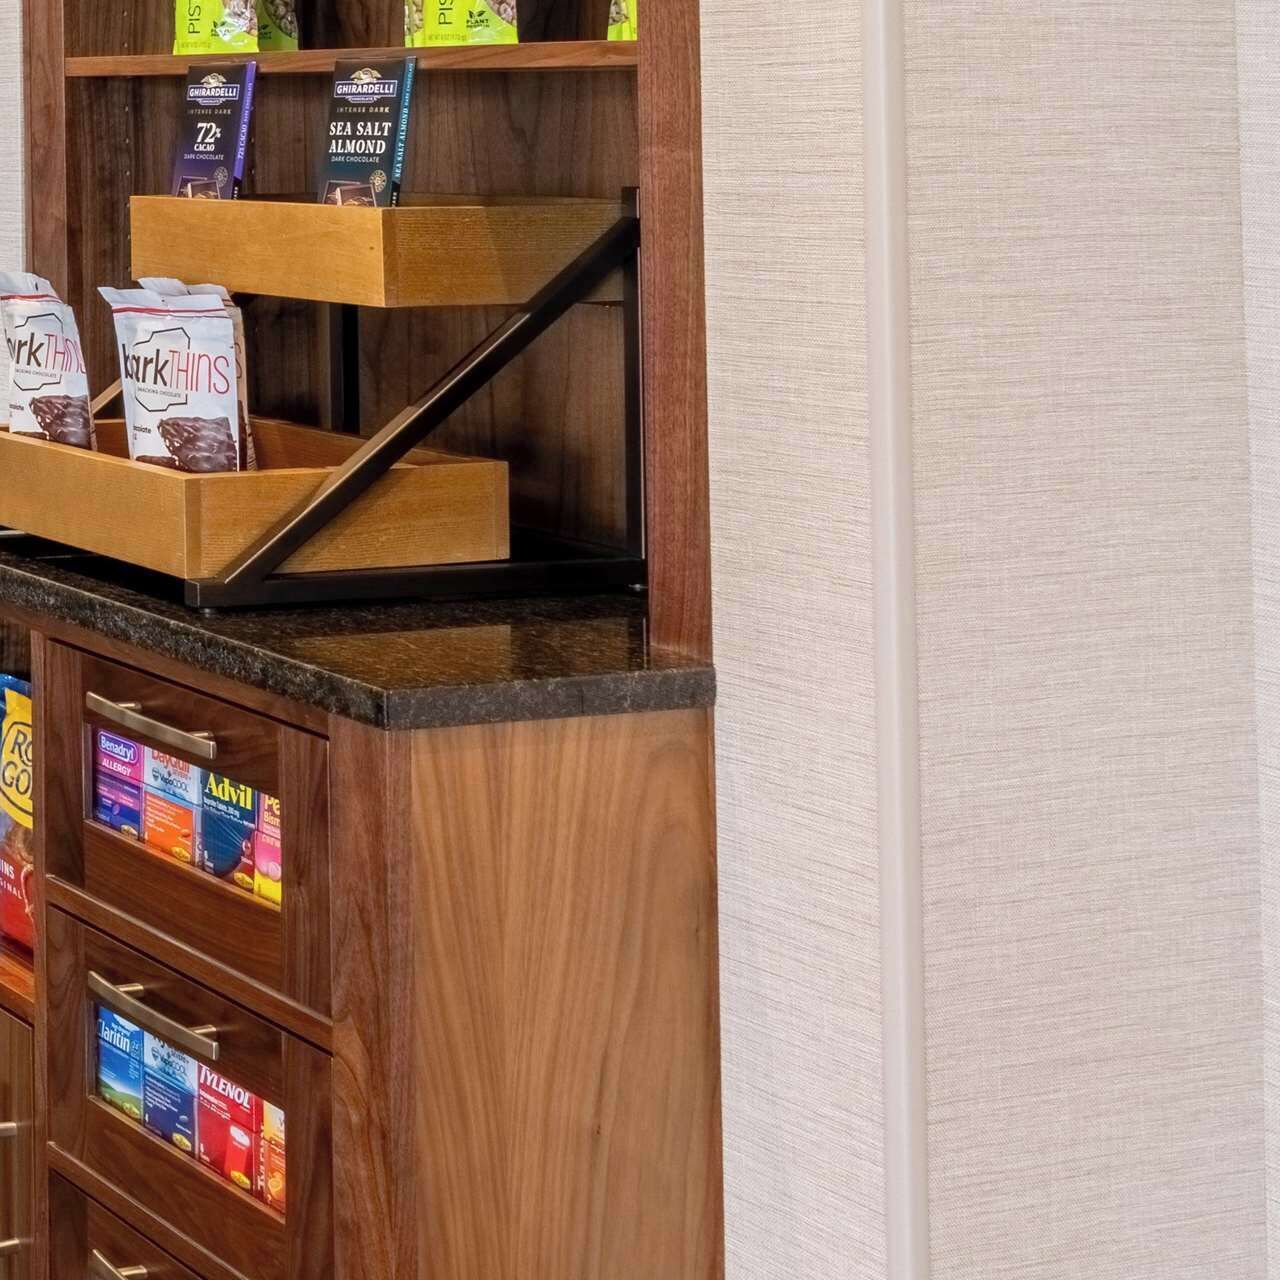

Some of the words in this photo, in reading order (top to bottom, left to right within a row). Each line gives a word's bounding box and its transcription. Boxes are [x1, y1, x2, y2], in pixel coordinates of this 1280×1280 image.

[189, 87, 237, 97] GHIRARDELLI
[336, 84, 394, 95] GHIRARDELLI
[329, 121, 352, 136] SEA
[356, 121, 392, 137] SALT
[400, 108, 409, 141] ALMOND
[239, 124, 248, 147] CACAO
[194, 143, 215, 151] CACAO
[328, 139, 386, 154] ALMOND
[397, 142, 405, 160] SALT
[196, 153, 224, 161] CHOCOLATE
[345, 155, 380, 163] CHOCOLATE
[11, 729, 33, 767] RO
[100, 736, 134, 763] Benadryl
[101, 758, 131, 776] ALLERGY
[2, 760, 32, 801] GO
[204, 771, 253, 811] Advil
[264, 811, 280, 827] Bism
[199, 1062, 252, 1110] TYLENOL
